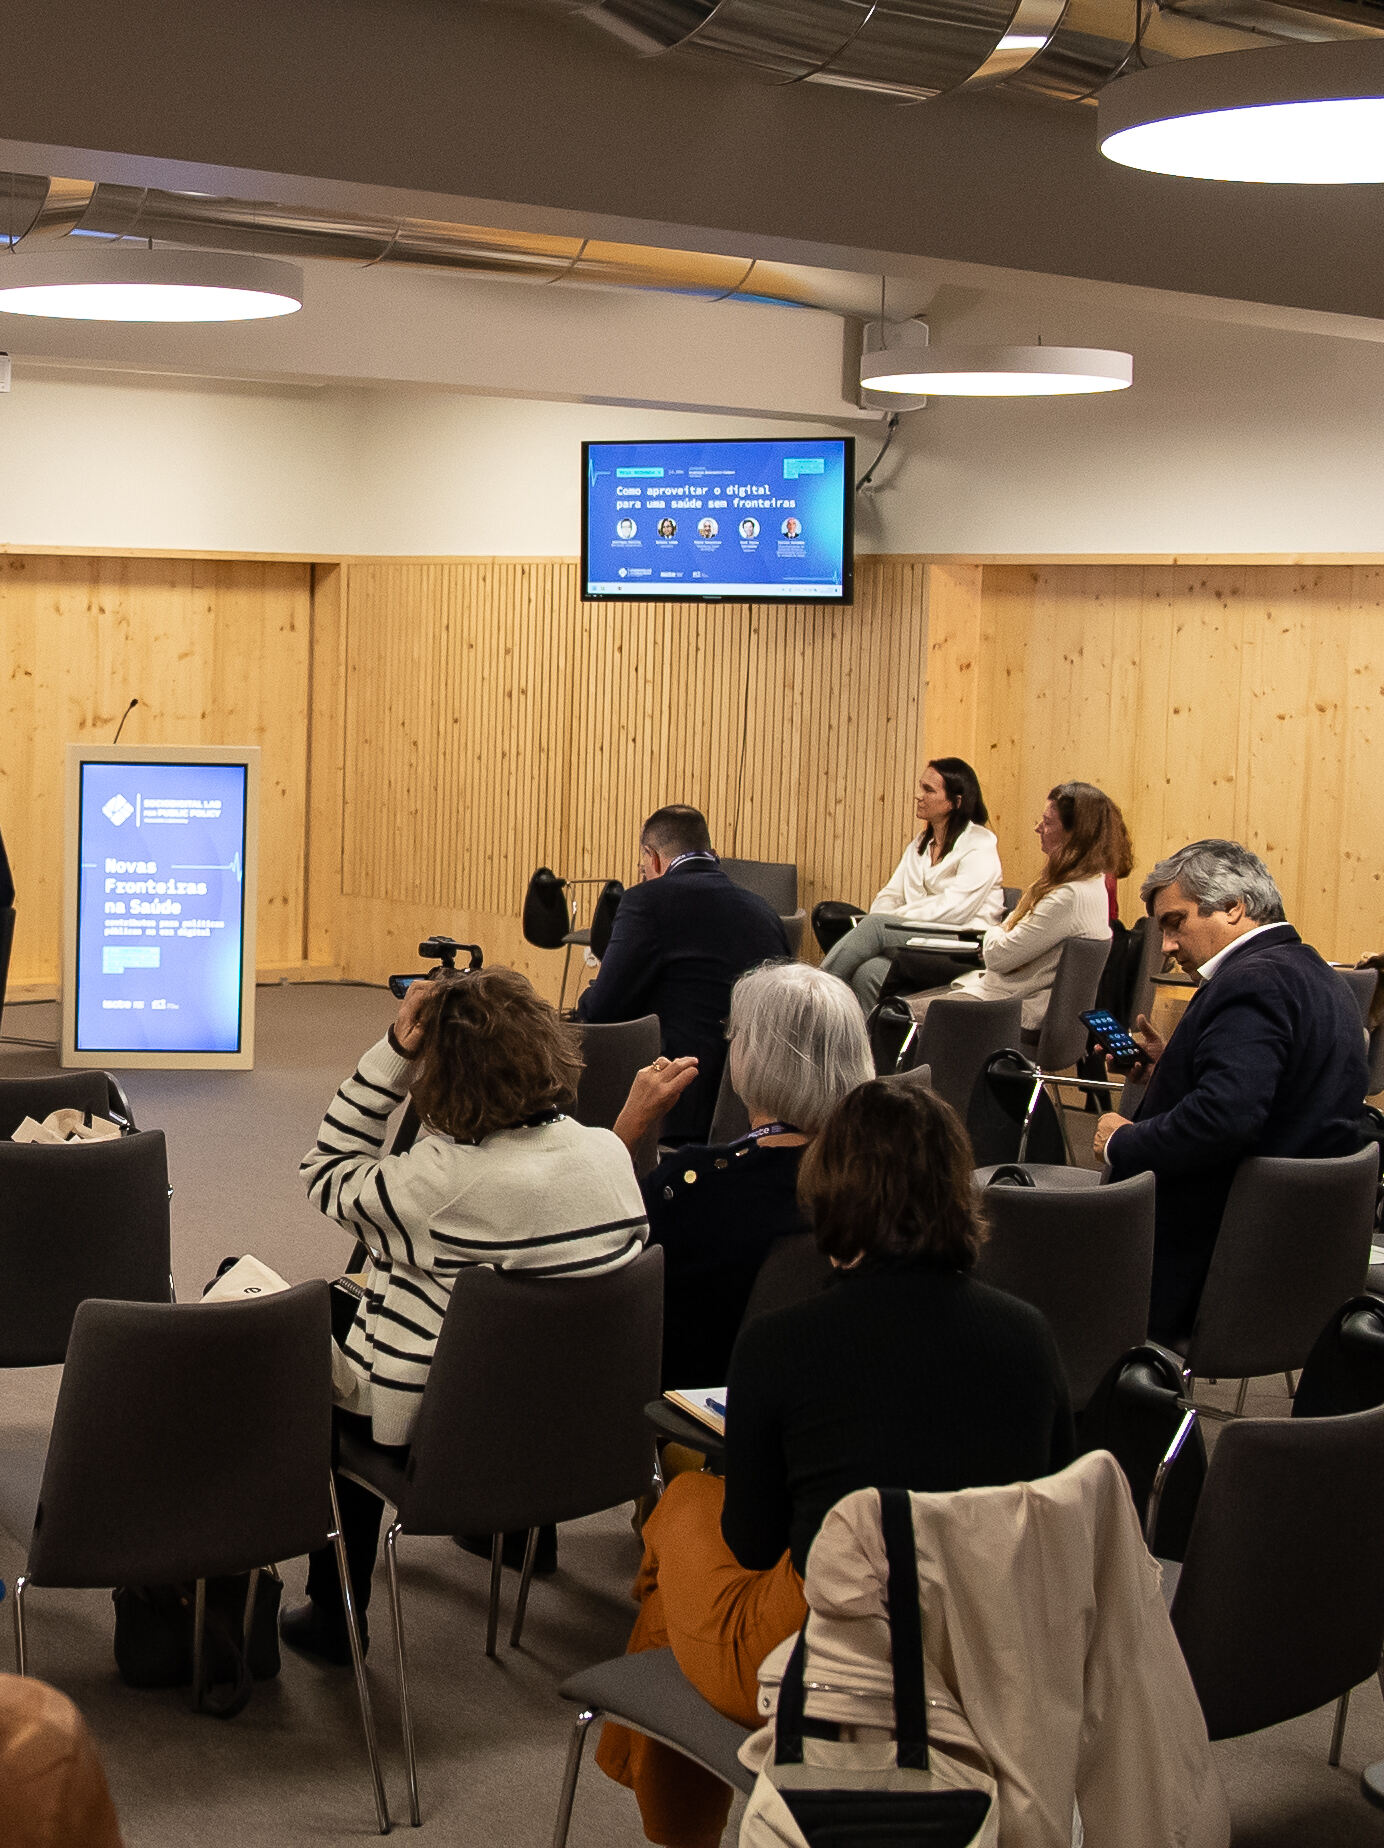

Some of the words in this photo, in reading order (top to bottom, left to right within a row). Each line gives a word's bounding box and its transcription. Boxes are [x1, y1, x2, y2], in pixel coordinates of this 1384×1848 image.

[616, 486, 642, 496] Como
[647, 485, 709, 498] aproveitar
[714, 488, 721, 496] o
[726, 485, 771, 498] digital
[616, 500, 642, 511] para
[646, 500, 666, 509] uma
[671, 497, 703, 509] saúde
[708, 500, 728, 509] sem
[733, 499, 796, 509] fronteiras
[105, 858, 157, 874] Novas
[105, 878, 208, 895] Fronteiras
[104, 901, 126, 914] na
[129, 898, 182, 915] Saúde
